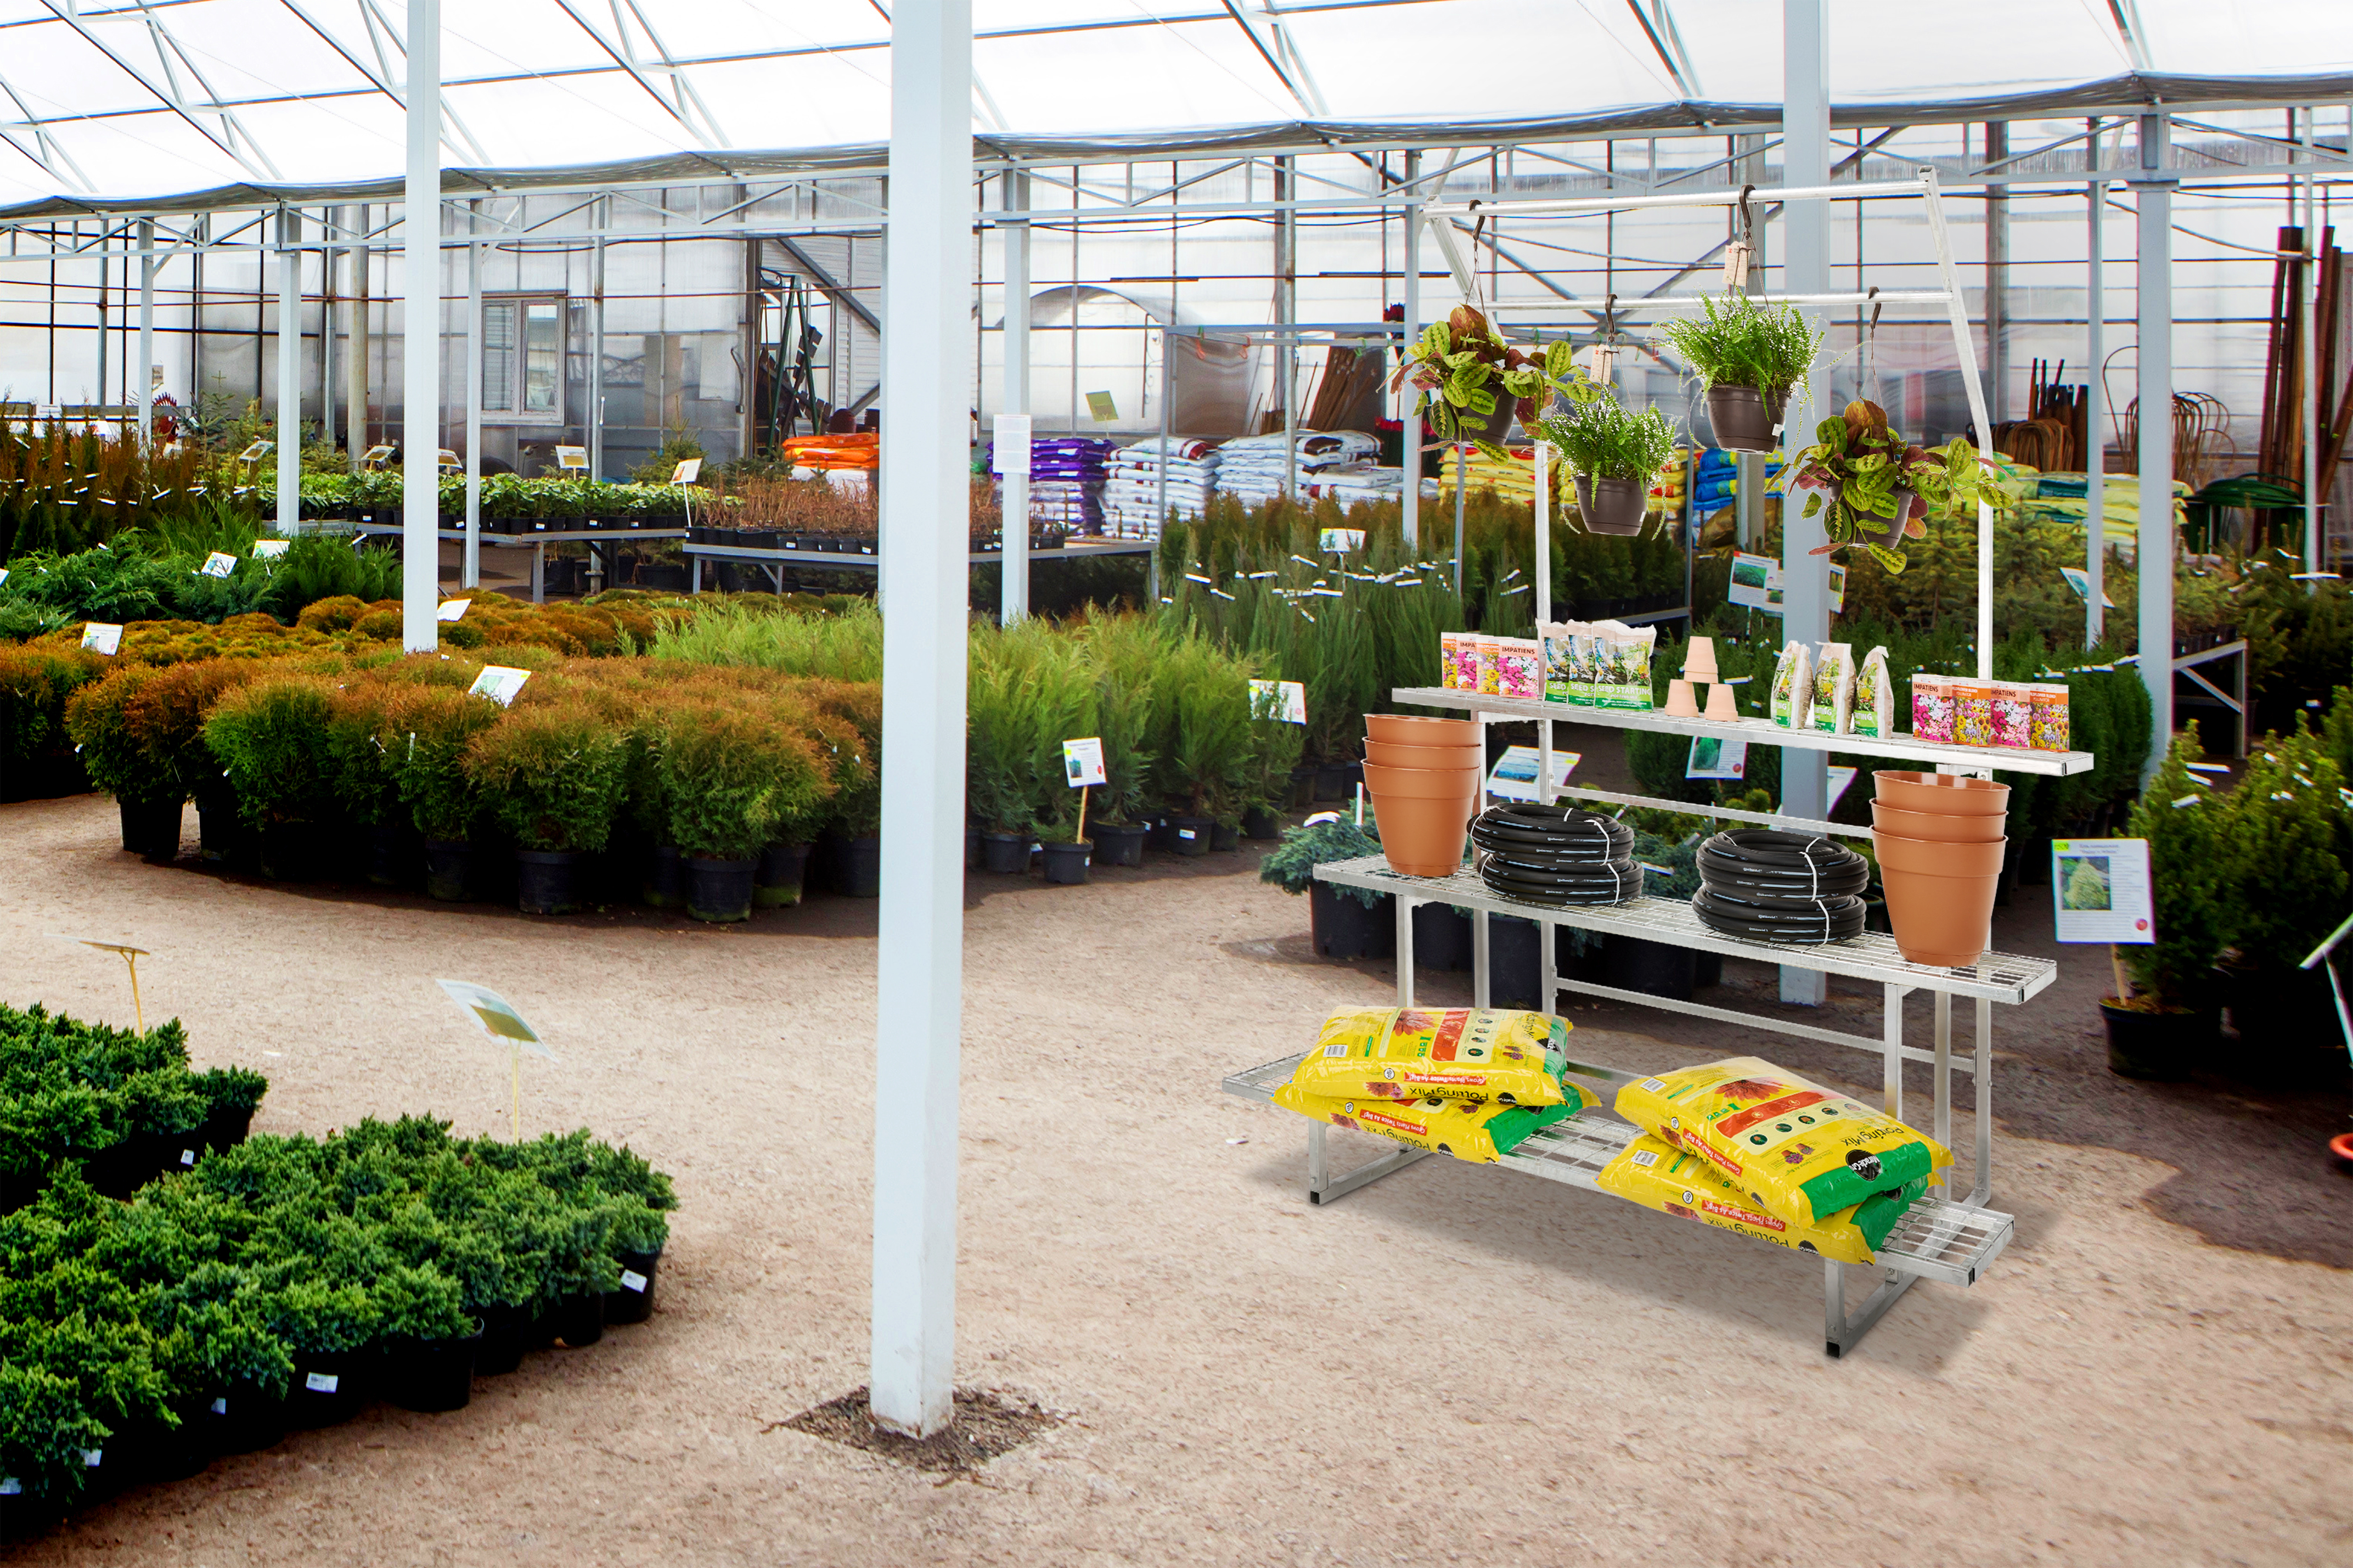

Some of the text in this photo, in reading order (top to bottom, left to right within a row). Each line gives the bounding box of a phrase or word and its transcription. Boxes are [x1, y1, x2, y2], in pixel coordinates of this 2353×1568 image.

[1502, 646, 1535, 655] IMPATIENS
[1571, 683, 1588, 692] SEED
[1617, 686, 1651, 695] STARTING
[1914, 683, 1938, 692] IMPATIENS
[1438, 1087, 1488, 1100] Potting
[1381, 1117, 1396, 1126] Twice
[1397, 1122, 1410, 1130] Plants
[1841, 1127, 1904, 1146] Potting Mix
[1727, 1162, 1740, 1174] Grows
[1728, 1210, 1746, 1220] Twice
[1747, 1215, 1764, 1225] Plants
[1765, 1220, 1783, 1230] Grows
[1735, 1223, 1789, 1247] Potting
